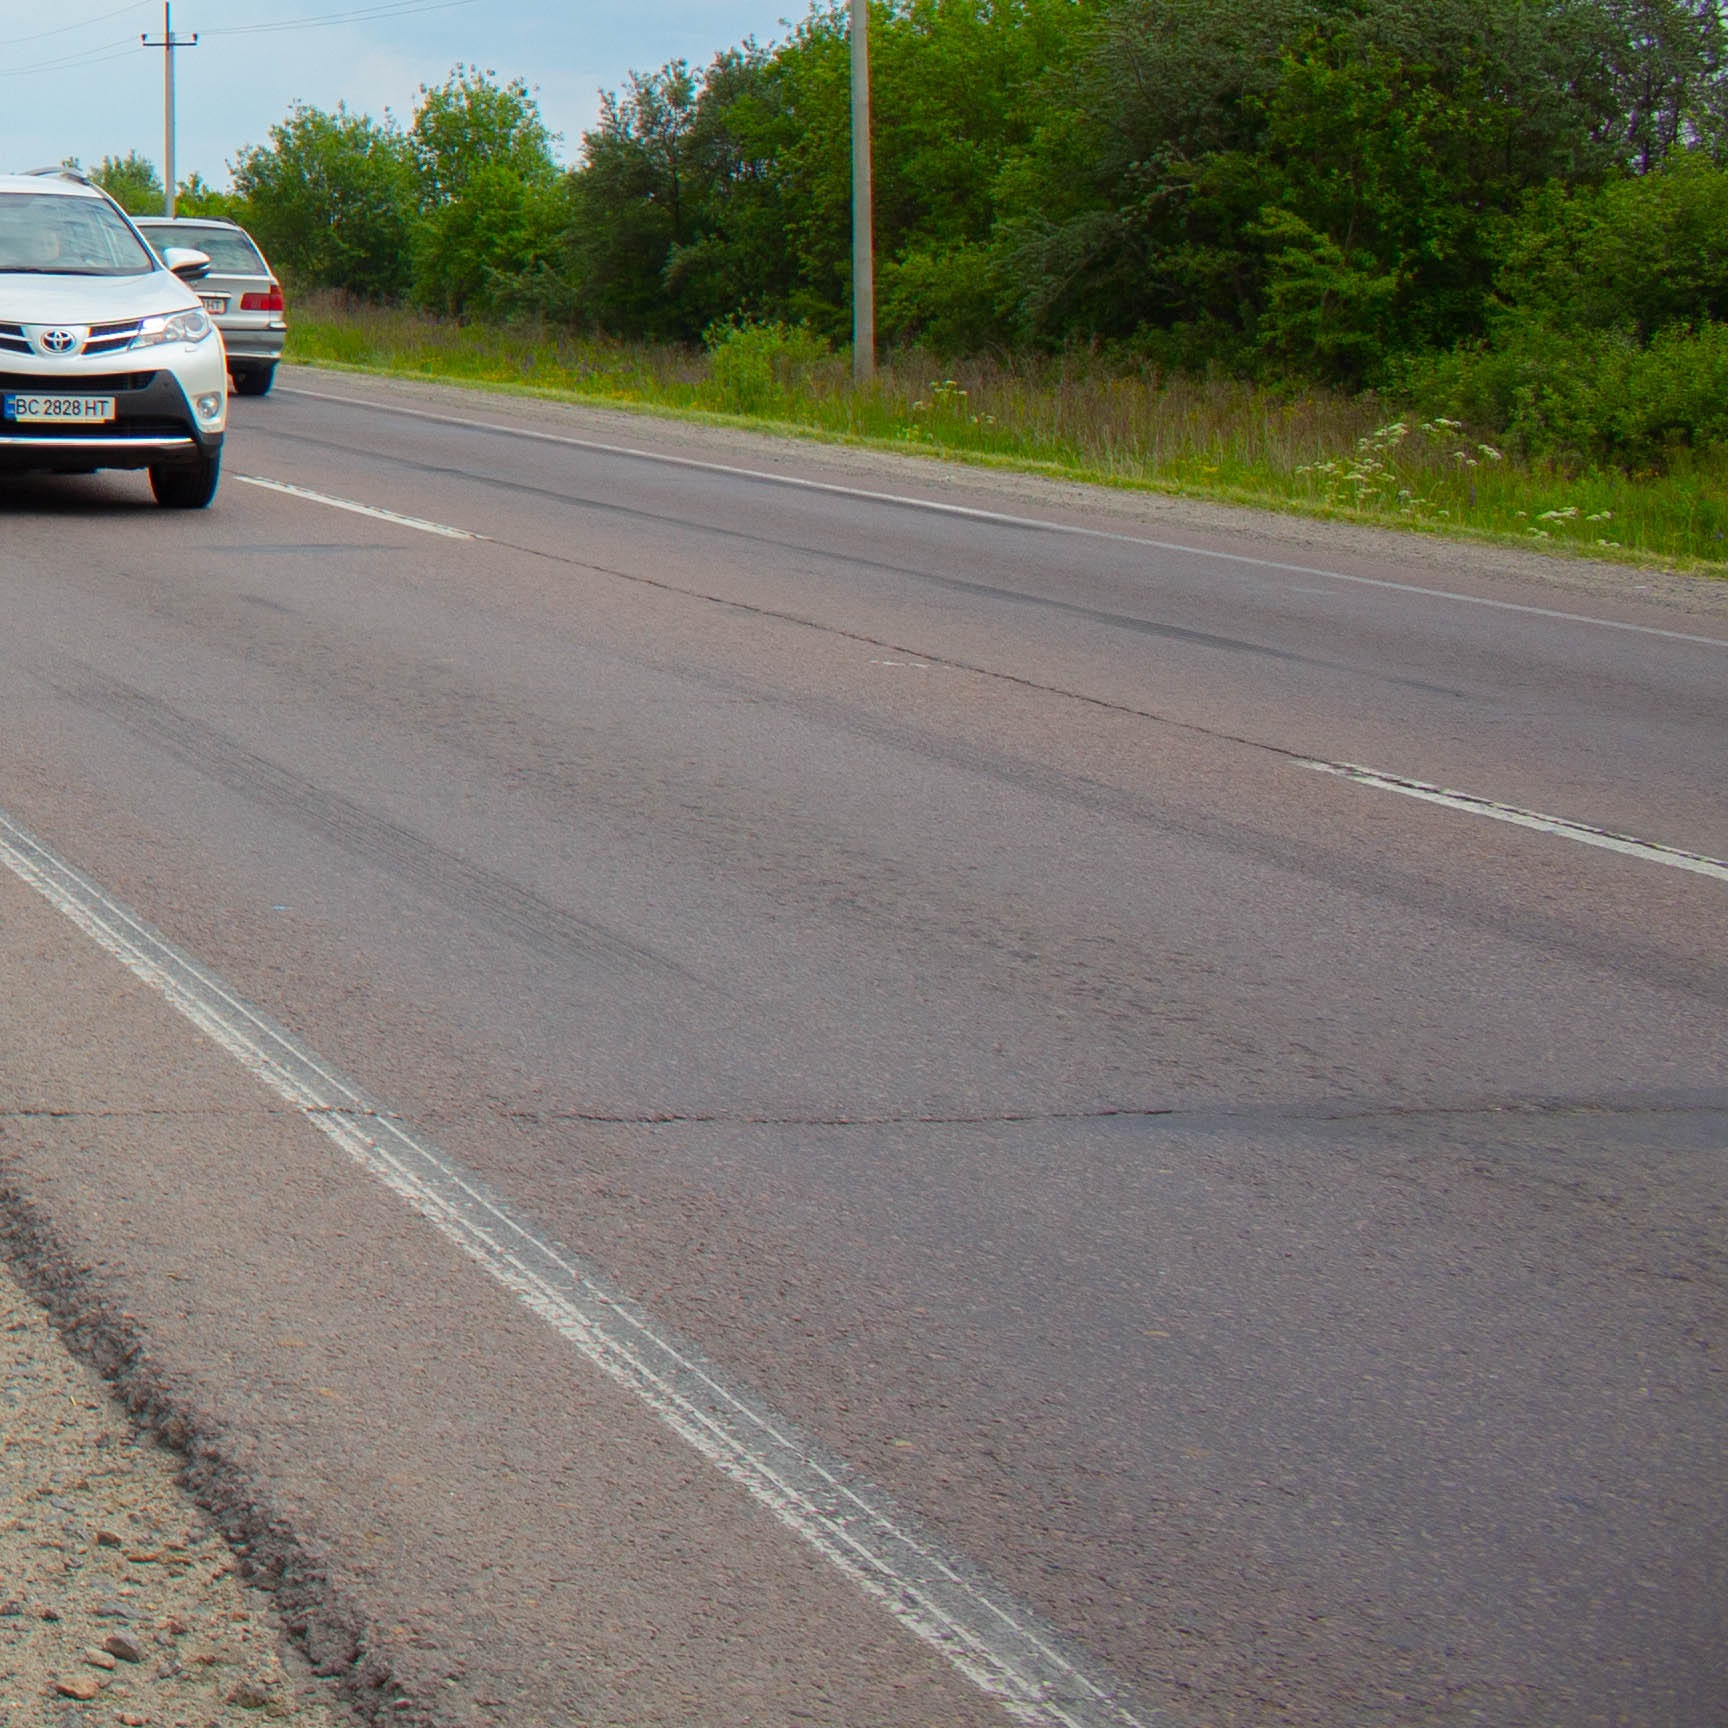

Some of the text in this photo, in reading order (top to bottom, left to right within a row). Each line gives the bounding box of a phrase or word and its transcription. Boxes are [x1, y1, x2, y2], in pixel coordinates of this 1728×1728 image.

[16, 398, 109, 416] BC 2828 HT
